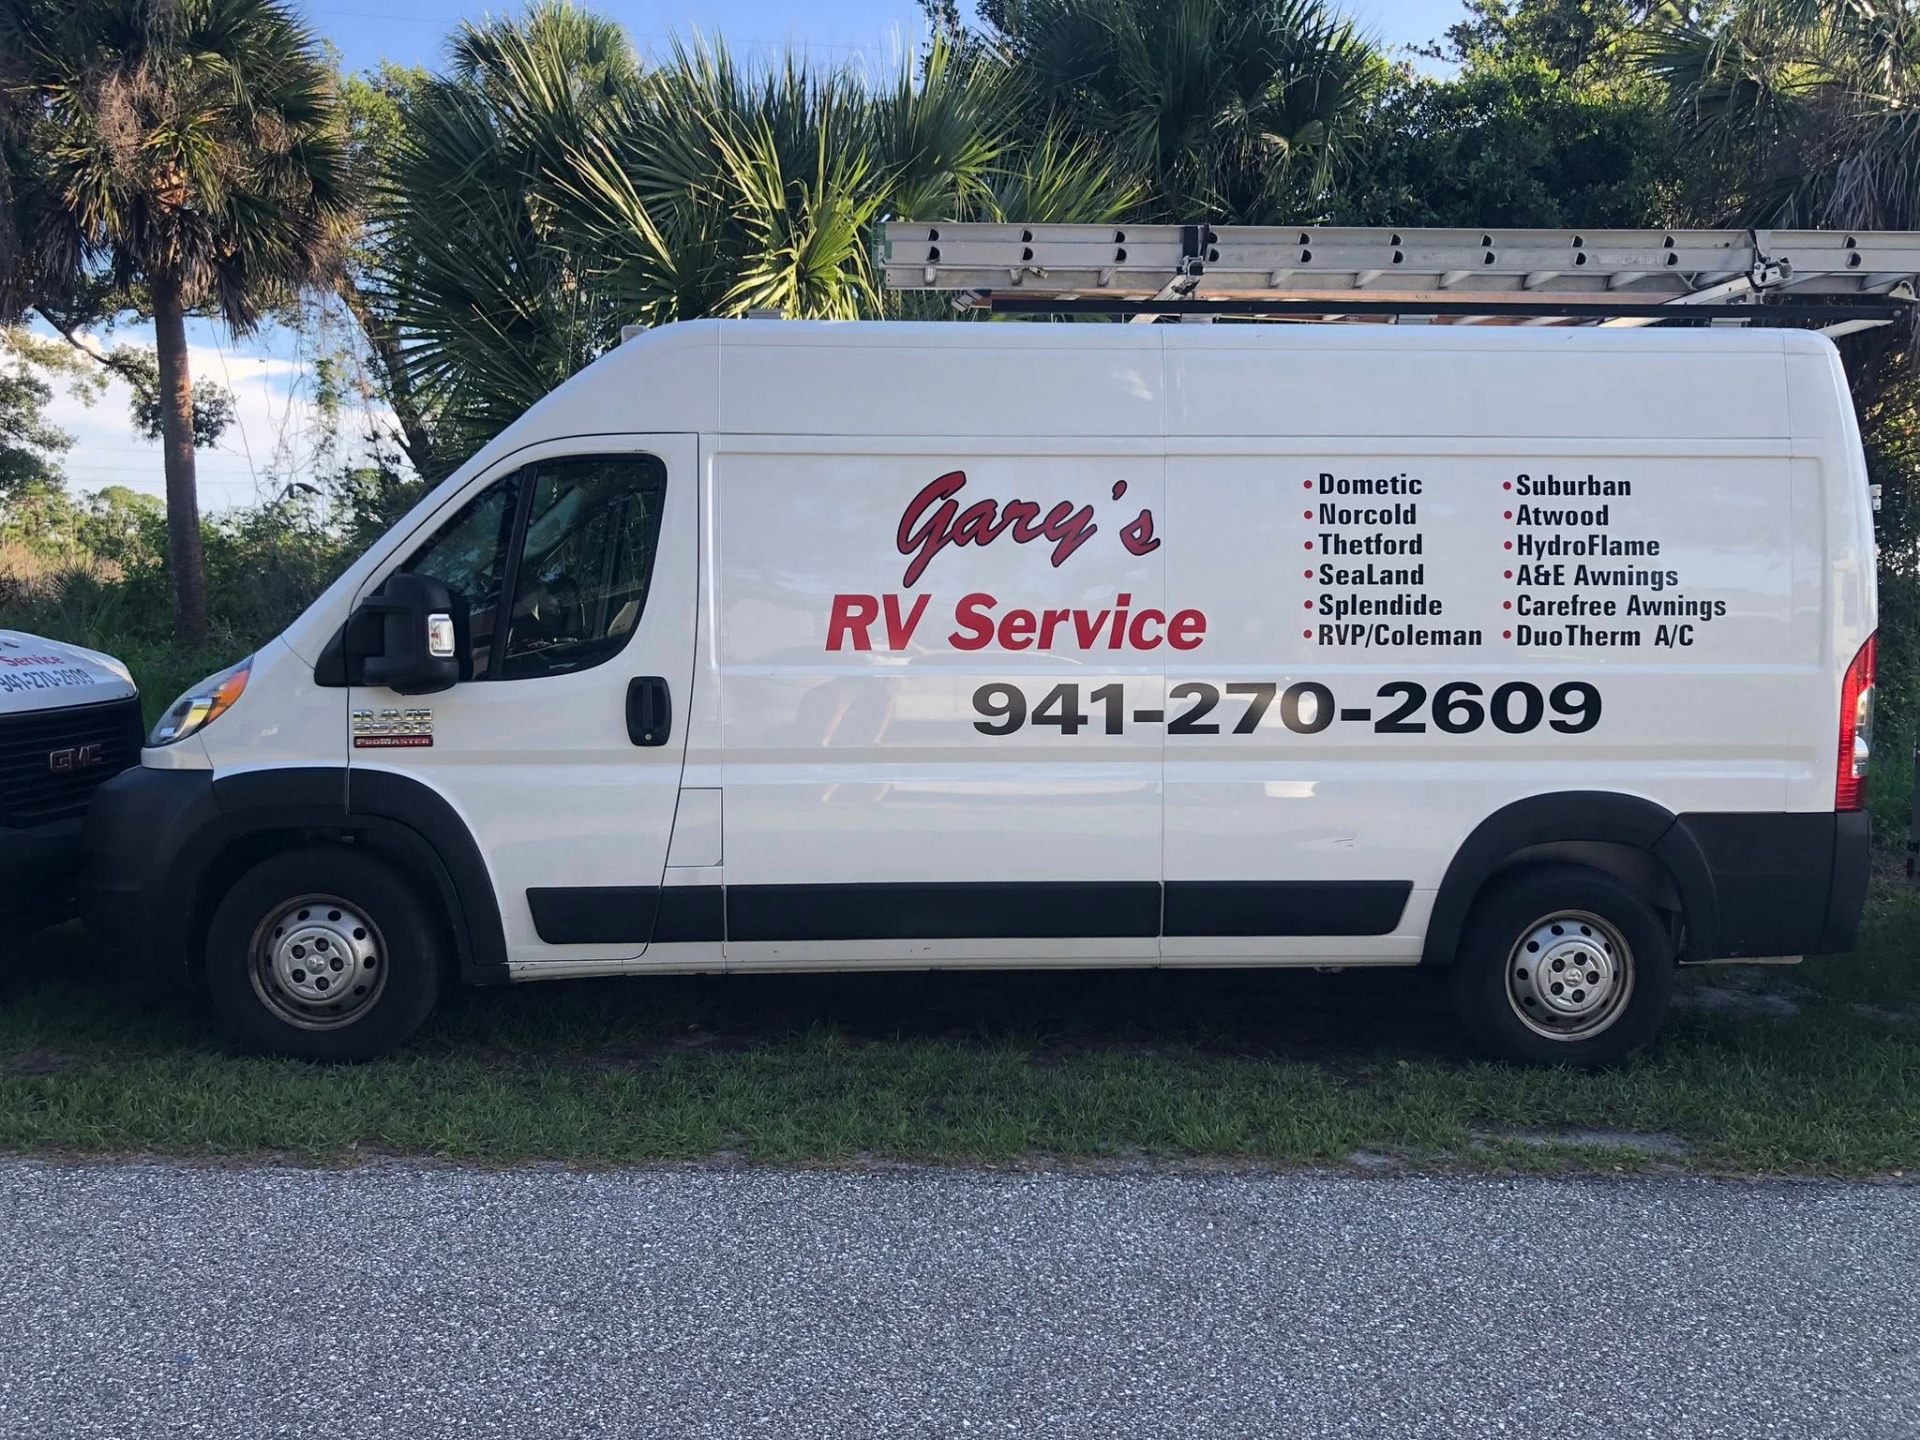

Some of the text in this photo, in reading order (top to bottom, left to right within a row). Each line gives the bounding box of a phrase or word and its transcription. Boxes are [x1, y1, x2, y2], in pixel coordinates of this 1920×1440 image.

[1319, 472, 1423, 495] Dometic
[1516, 474, 1632, 497] Suburban
[1319, 502, 1417, 525] Norcold
[1516, 504, 1609, 527] Atwood
[896, 470, 1161, 589] Gary's
[1319, 533, 1423, 555] Thetford
[1517, 534, 1660, 561] HydroFlame
[1319, 563, 1424, 586] SeaLand
[1516, 564, 1679, 592] A&E Awnings
[1318, 593, 1443, 621] Splendide
[1517, 594, 1727, 621] Carefree Awnings
[825, 592, 1207, 651] RV Service
[1318, 623, 1482, 648] RVP/Coleman
[1654, 624, 1694, 649] A/C
[352, 708, 433, 721] RAM
[972, 681, 1603, 736] 941-270-2609
[352, 721, 433, 735] 2500
[50, 744, 102, 770] GMC
